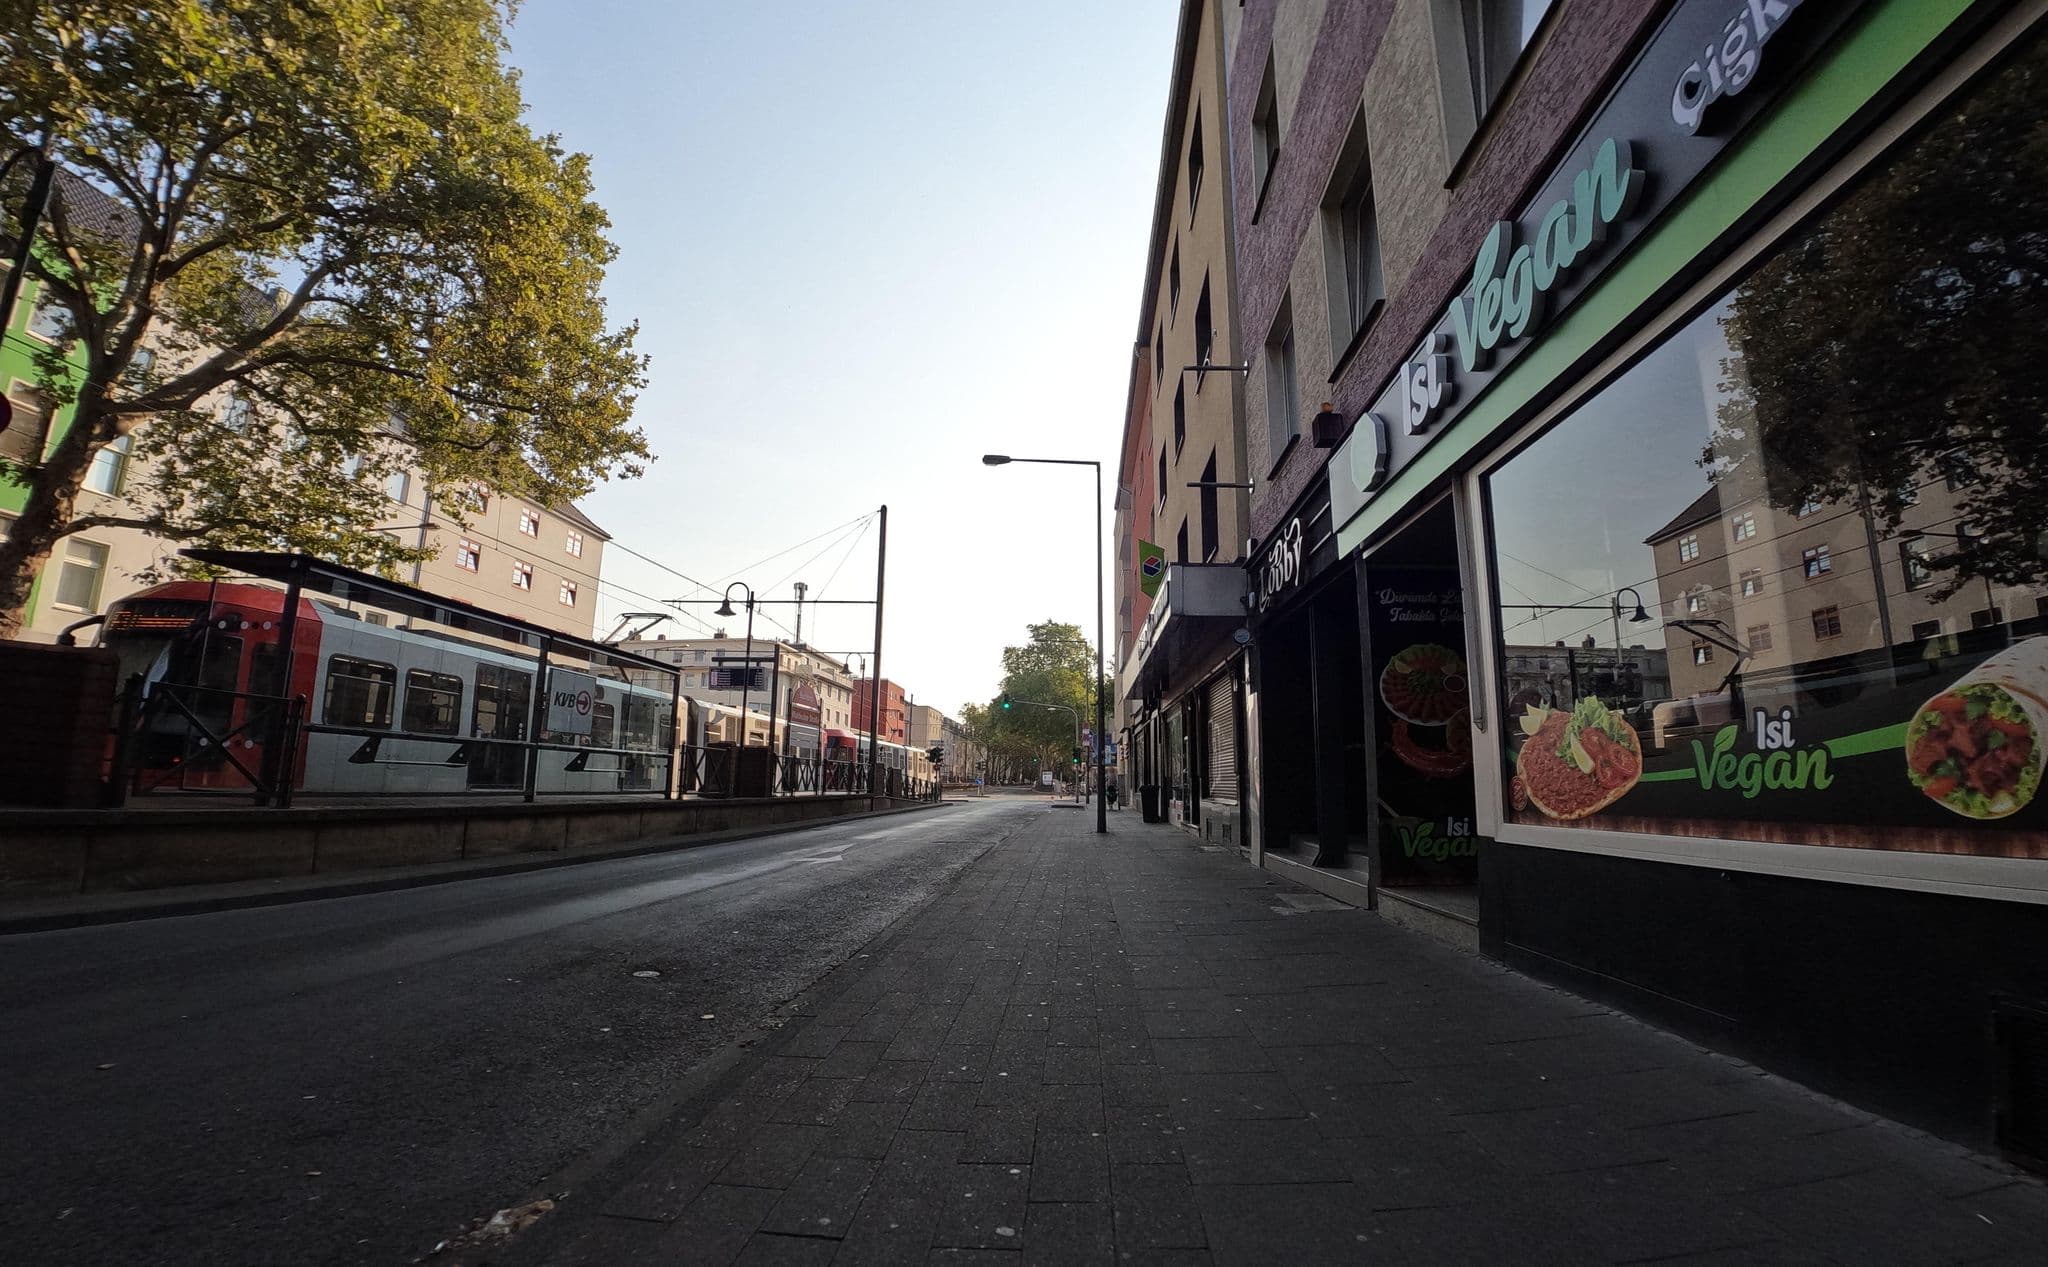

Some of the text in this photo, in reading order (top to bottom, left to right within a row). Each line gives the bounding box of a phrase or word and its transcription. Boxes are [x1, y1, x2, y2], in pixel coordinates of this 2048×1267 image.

[1400, 331, 1443, 437] Isi
[1447, 136, 1635, 374] Vegan
[554, 691, 576, 708] KVB
[1756, 709, 1796, 750] Isi
[1690, 724, 1834, 799] Vegan
[1447, 815, 1471, 838] Isi
